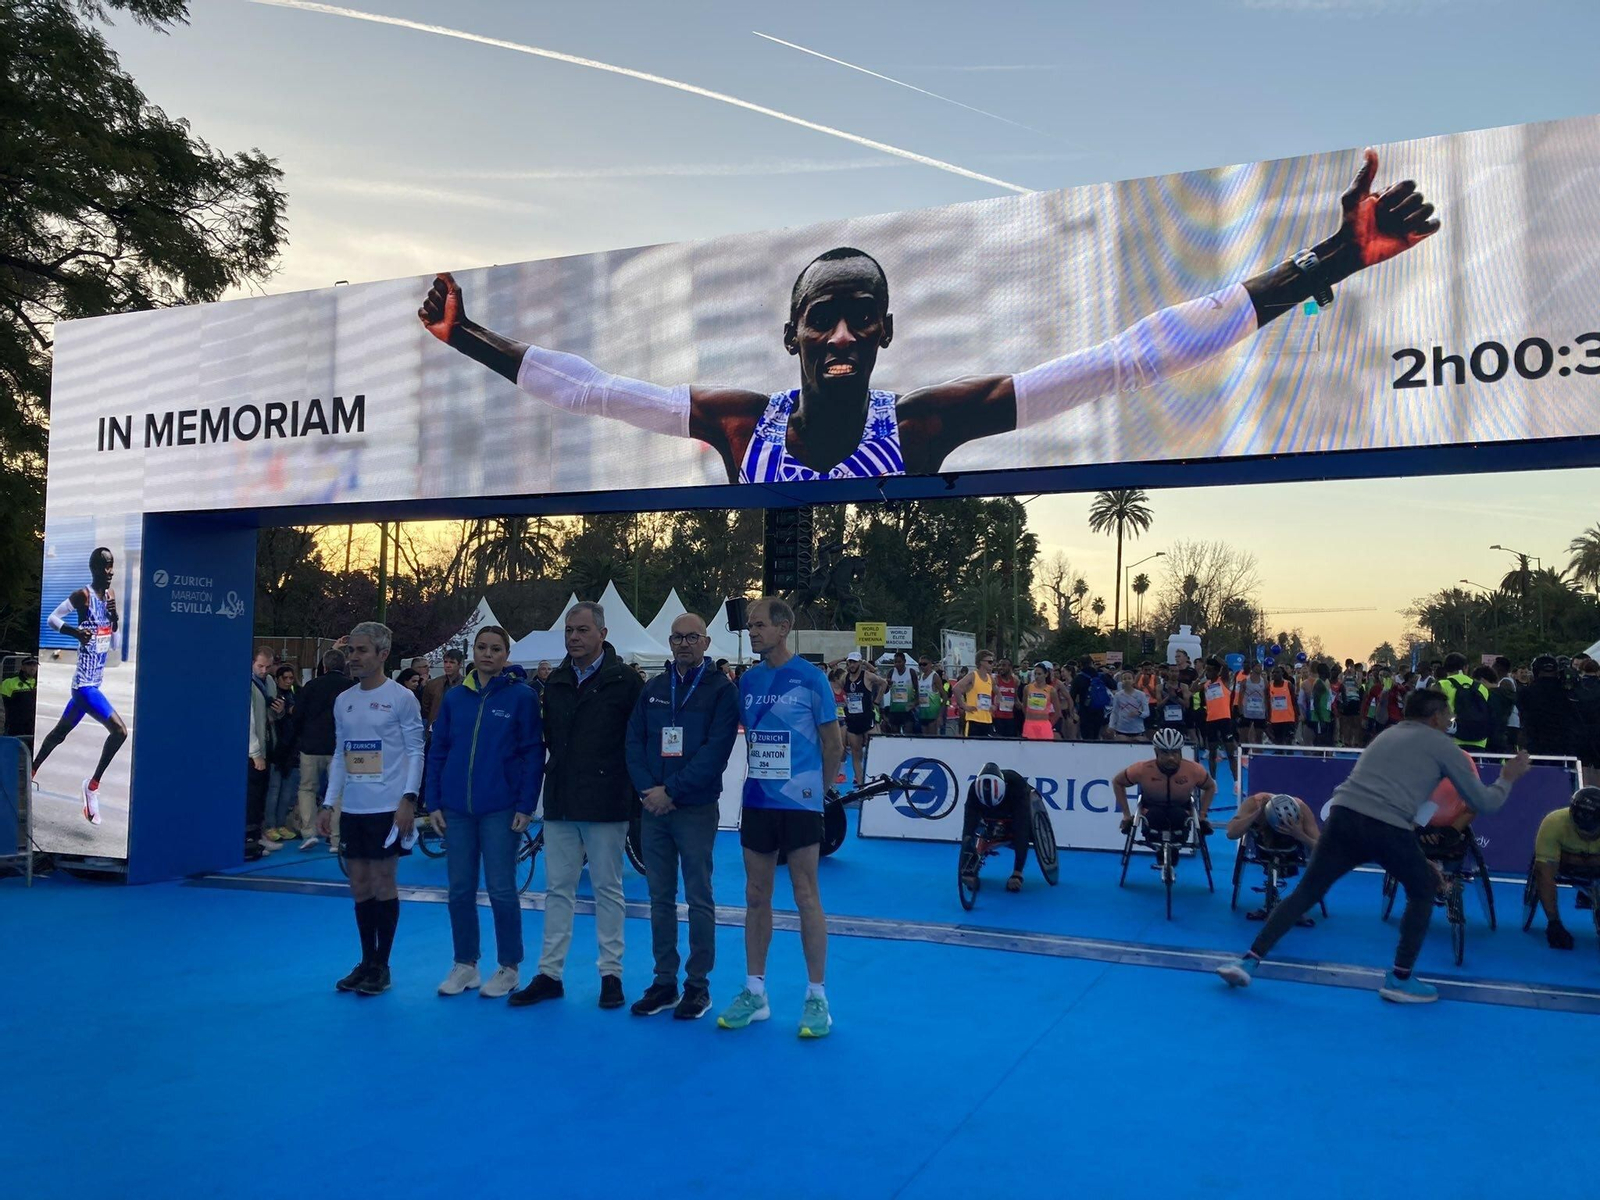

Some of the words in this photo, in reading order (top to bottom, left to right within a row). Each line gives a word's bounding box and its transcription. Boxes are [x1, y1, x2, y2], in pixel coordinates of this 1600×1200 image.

[98, 415, 133, 452] IN
[144, 394, 366, 449] MEMORIAM
[173, 575, 213, 588] ZURICH
[171, 590, 213, 602] MARATÓN
[170, 602, 213, 614] SEVILLA
[755, 694, 798, 705] ZURICH
[758, 734, 783, 742] ZURICH
[352, 742, 376, 750] ZURICH
[762, 750, 785, 759] ANTON
